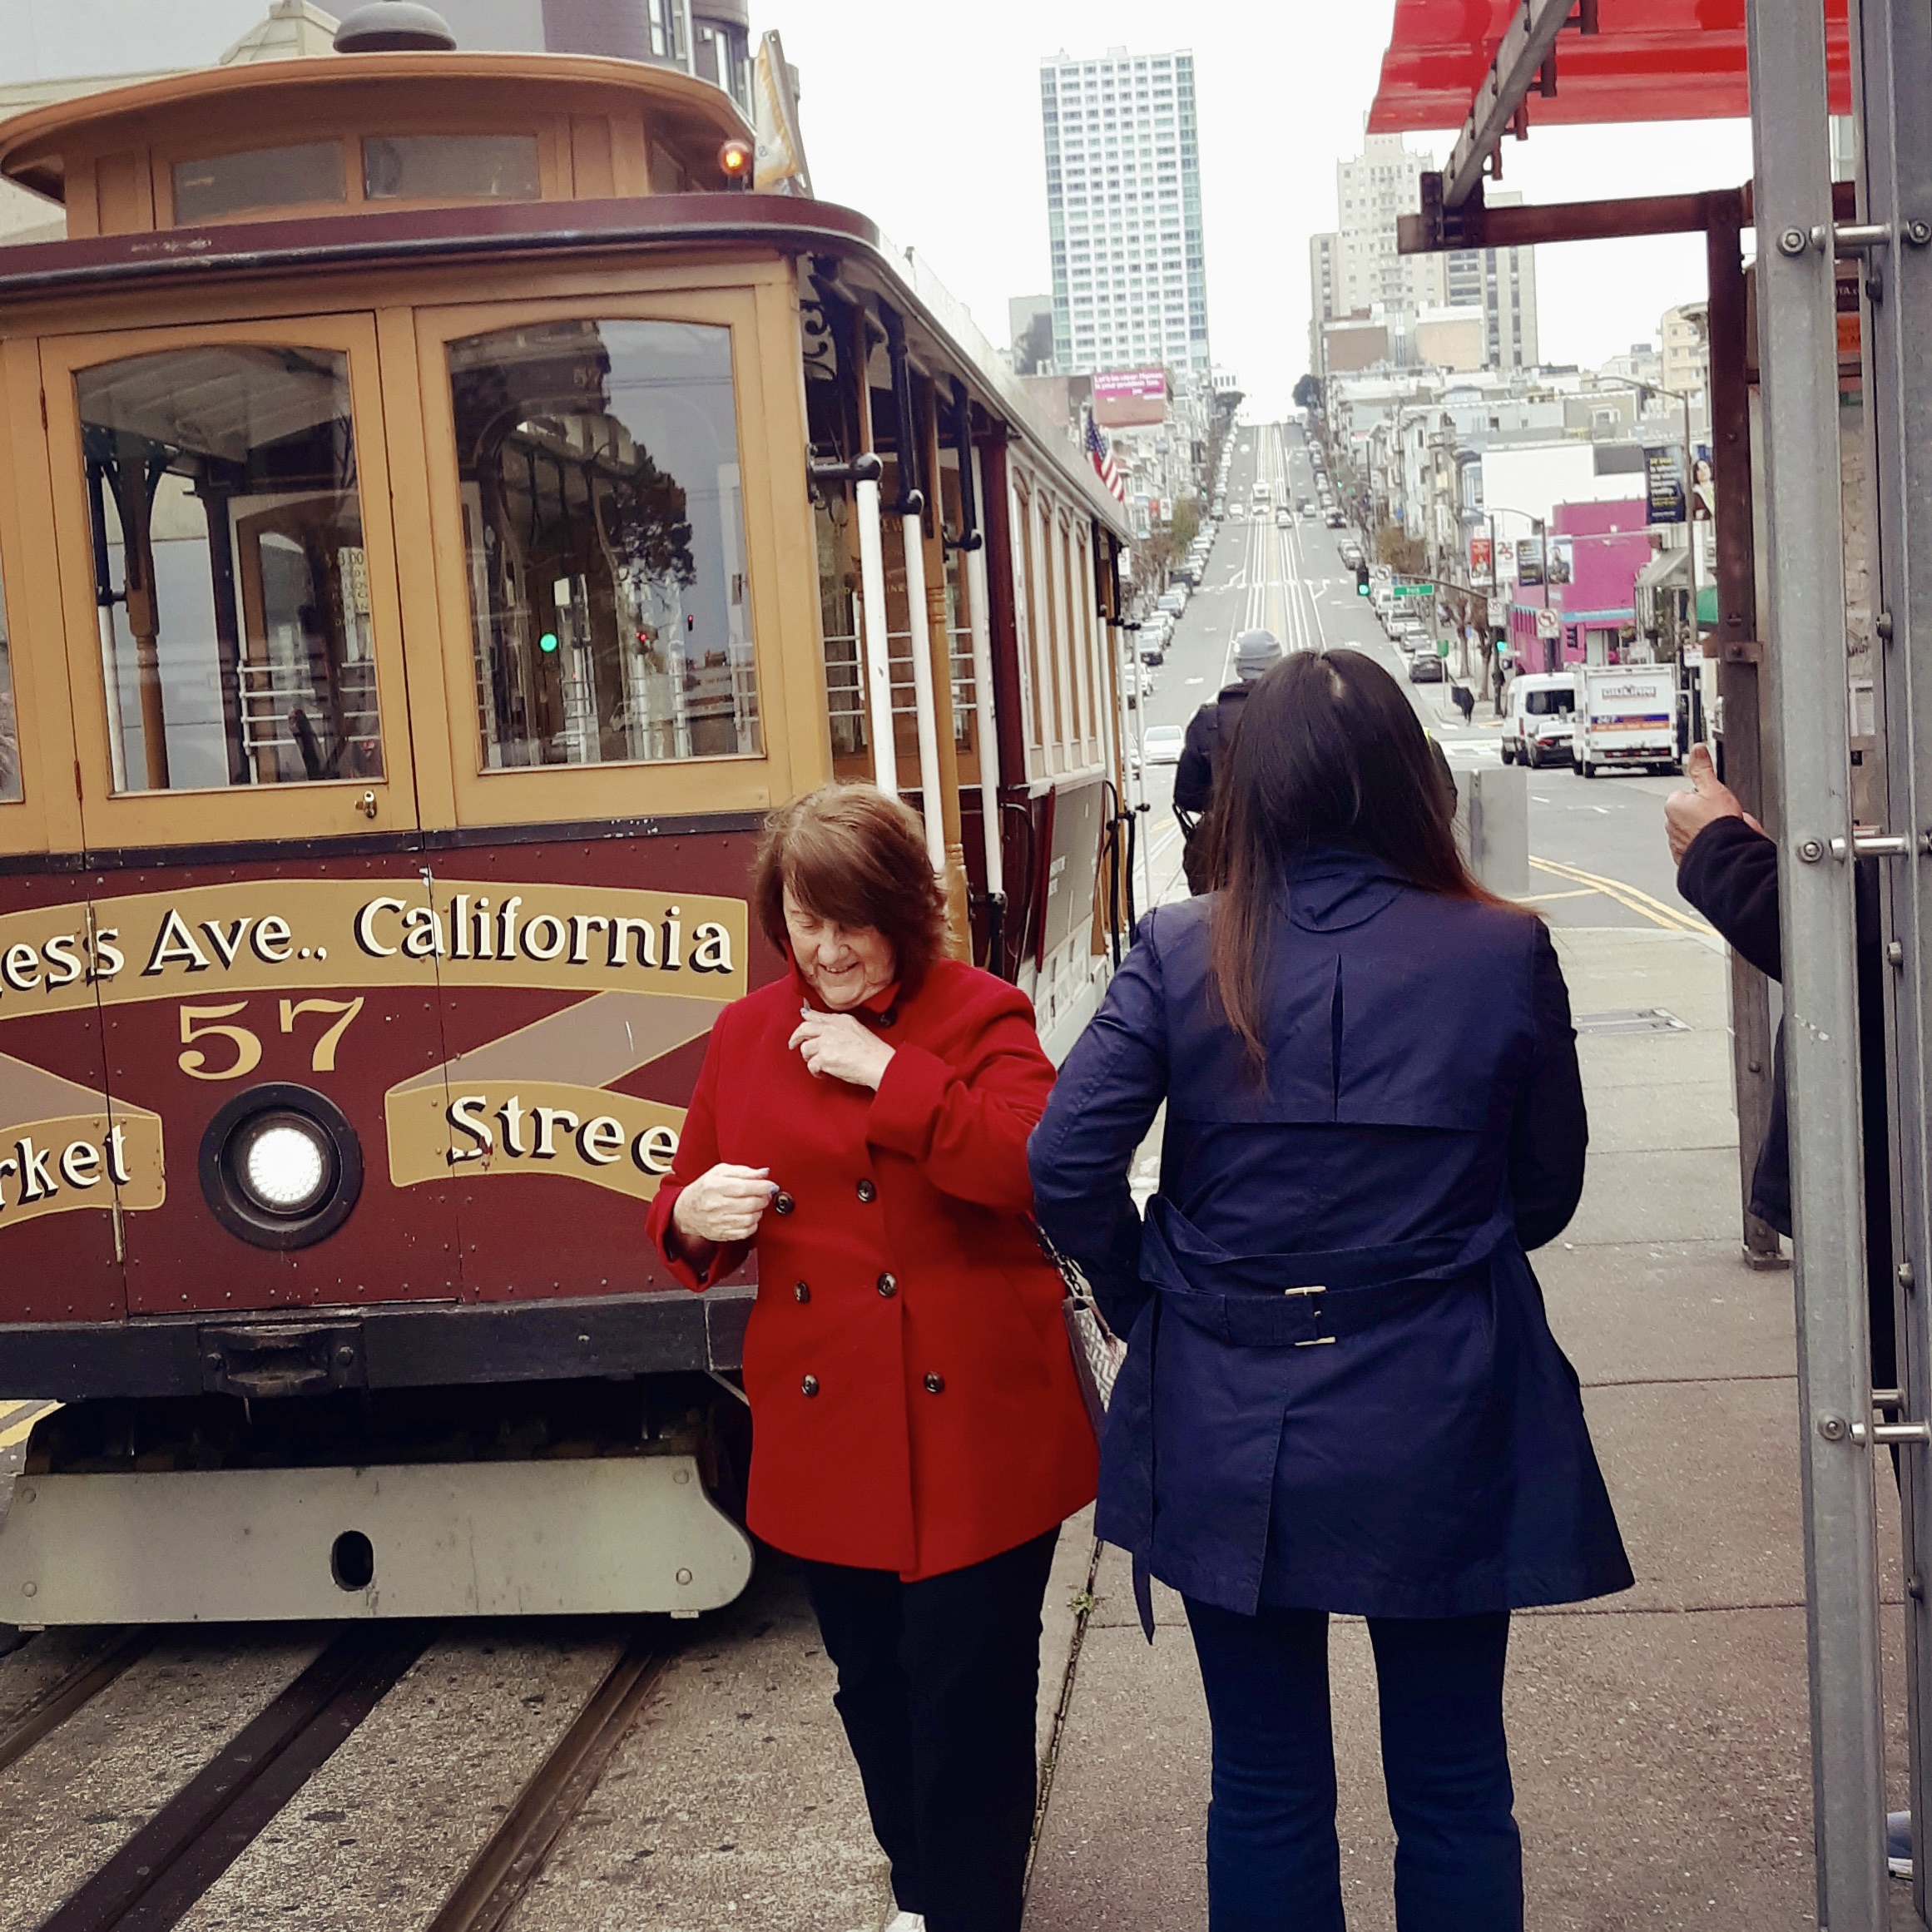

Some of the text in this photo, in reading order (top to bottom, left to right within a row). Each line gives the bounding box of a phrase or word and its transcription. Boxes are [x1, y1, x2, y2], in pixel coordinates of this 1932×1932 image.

[0, 927, 126, 998] ess
[354, 893, 736, 974] California
[177, 996, 365, 1081] 57
[446, 1094, 680, 1177] Stree
